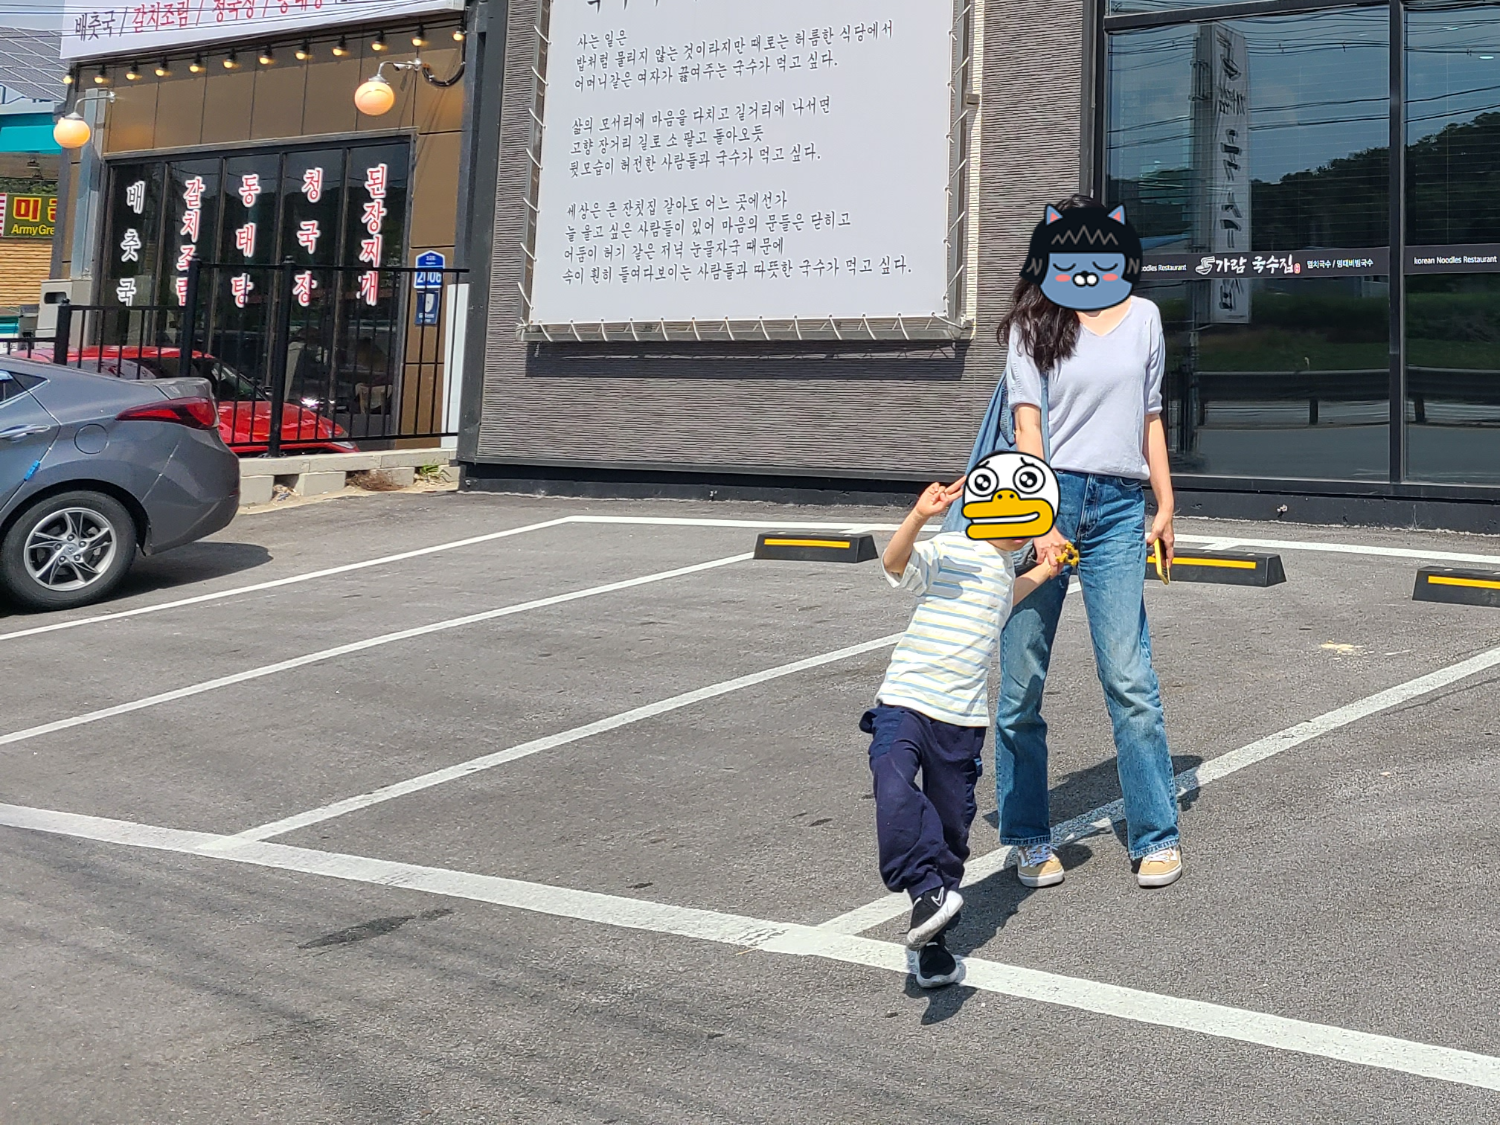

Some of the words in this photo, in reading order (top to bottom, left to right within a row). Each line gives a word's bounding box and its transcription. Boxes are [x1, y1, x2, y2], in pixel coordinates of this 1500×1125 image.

[74, 8, 116, 42] 배춧국
[578, 34, 599, 50] 사는
[605, 30, 627, 47] 일은
[577, 52, 608, 71] 밥처럼
[615, 48, 647, 67] 물리지
[656, 46, 678, 63] 않는
[684, 37, 745, 60] 것이라지만
[751, 34, 789, 52] 때로는
[795, 27, 834, 47] 허름한
[840, 20, 892, 42] 식당에서
[638, 67, 673, 86] 여자가
[678, 63, 727, 82] 끓여주는
[733, 57, 770, 76] 국수가
[777, 55, 801, 72] 먹고
[808, 50, 837, 69] 싶다.
[572, 117, 592, 135] 삶의
[599, 112, 644, 131] 모서리에
[652, 109, 687, 127] 마음을
[693, 106, 729, 124] 다치고
[735, 100, 784, 121] 길거리에
[793, 96, 829, 115] 나서면
[571, 138, 593, 155] 고향
[599, 135, 631, 154] 장거리
[639, 134, 661, 151] 길로
[666, 133, 677, 147] 소
[684, 130, 707, 147] 팔고
[713, 125, 763, 145] 돌아오듯
[570, 158, 613, 177] 뒷모습이
[621, 155, 656, 173] 허전한
[661, 151, 710, 170] 사람들과
[716, 148, 753, 167] 국수가
[760, 146, 784, 163] 먹고
[790, 143, 820, 162] 싶다.
[567, 203, 601, 219] 세상은
[606, 202, 617, 217] 큰
[623, 198, 656, 217] 잔칫집
[664, 197, 699, 214] 같아도
[706, 195, 729, 211] 어느
[736, 191, 787, 211] 곳에선가
[116, 180, 146, 307] 배춧국
[231, 174, 262, 308] 동태탕
[292, 167, 323, 307] 청국장
[356, 163, 388, 307] 된장찌개
[565, 226, 576, 242] 늘
[581, 225, 604, 241] 울고
[609, 222, 632, 239] 싶은
[638, 219, 684, 237] 사람들이
[692, 217, 714, 235] 있어
[722, 215, 757, 234] 마음의
[765, 214, 804, 232] 문들은
[811, 211, 850, 230] 닫히고
[604, 244, 624, 260] 허기
[632, 243, 655, 260] 같은
[661, 241, 683, 259] 저녁
[690, 239, 740, 258] 눈물자국
[747, 237, 783, 255] 때문에
[1215, 256, 1247, 274] 가람
[1252, 254, 1294, 274] 국수집
[1463, 255, 1498, 263] Restaurant
[563, 267, 583, 284] 속이
[619, 264, 691, 283] 들여다보이는
[698, 261, 748, 280] 사람들과
[754, 260, 793, 278] 따뜻한
[799, 258, 839, 277] 국수가
[846, 257, 872, 275] 먹고
[879, 255, 911, 274] 싶다.
